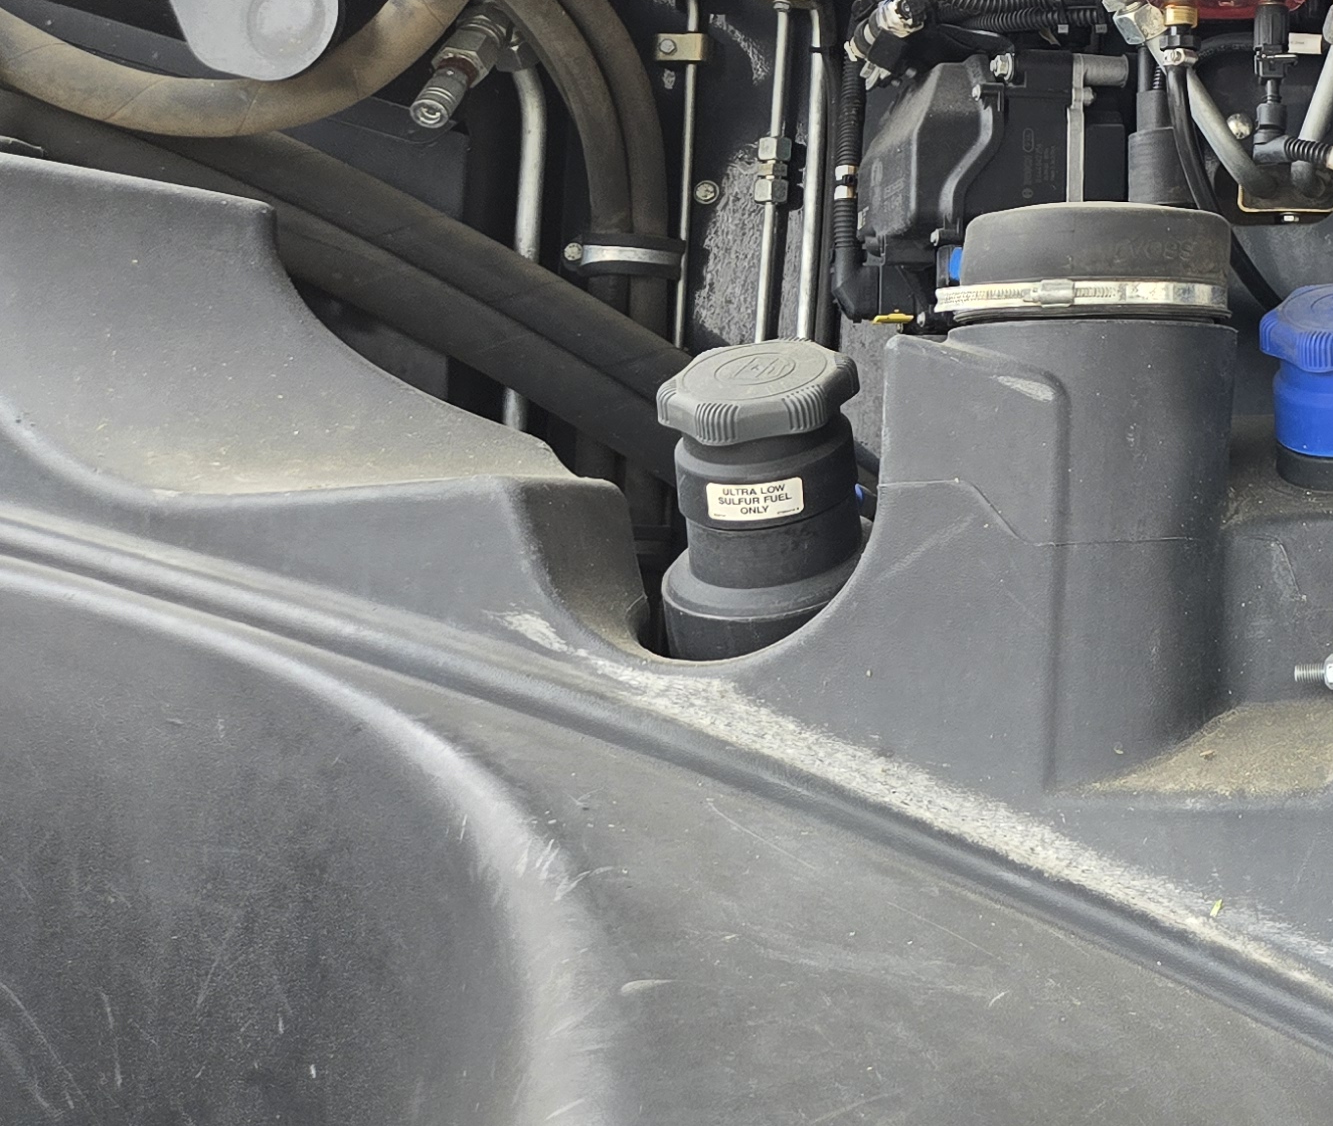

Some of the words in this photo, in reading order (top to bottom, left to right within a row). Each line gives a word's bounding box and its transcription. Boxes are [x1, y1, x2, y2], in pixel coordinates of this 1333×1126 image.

[722, 487, 757, 497] ULTRA
[760, 483, 786, 494] LOW
[717, 496, 761, 506] SULFUR
[763, 492, 792, 504] FUEL
[740, 504, 769, 515] ONLY
